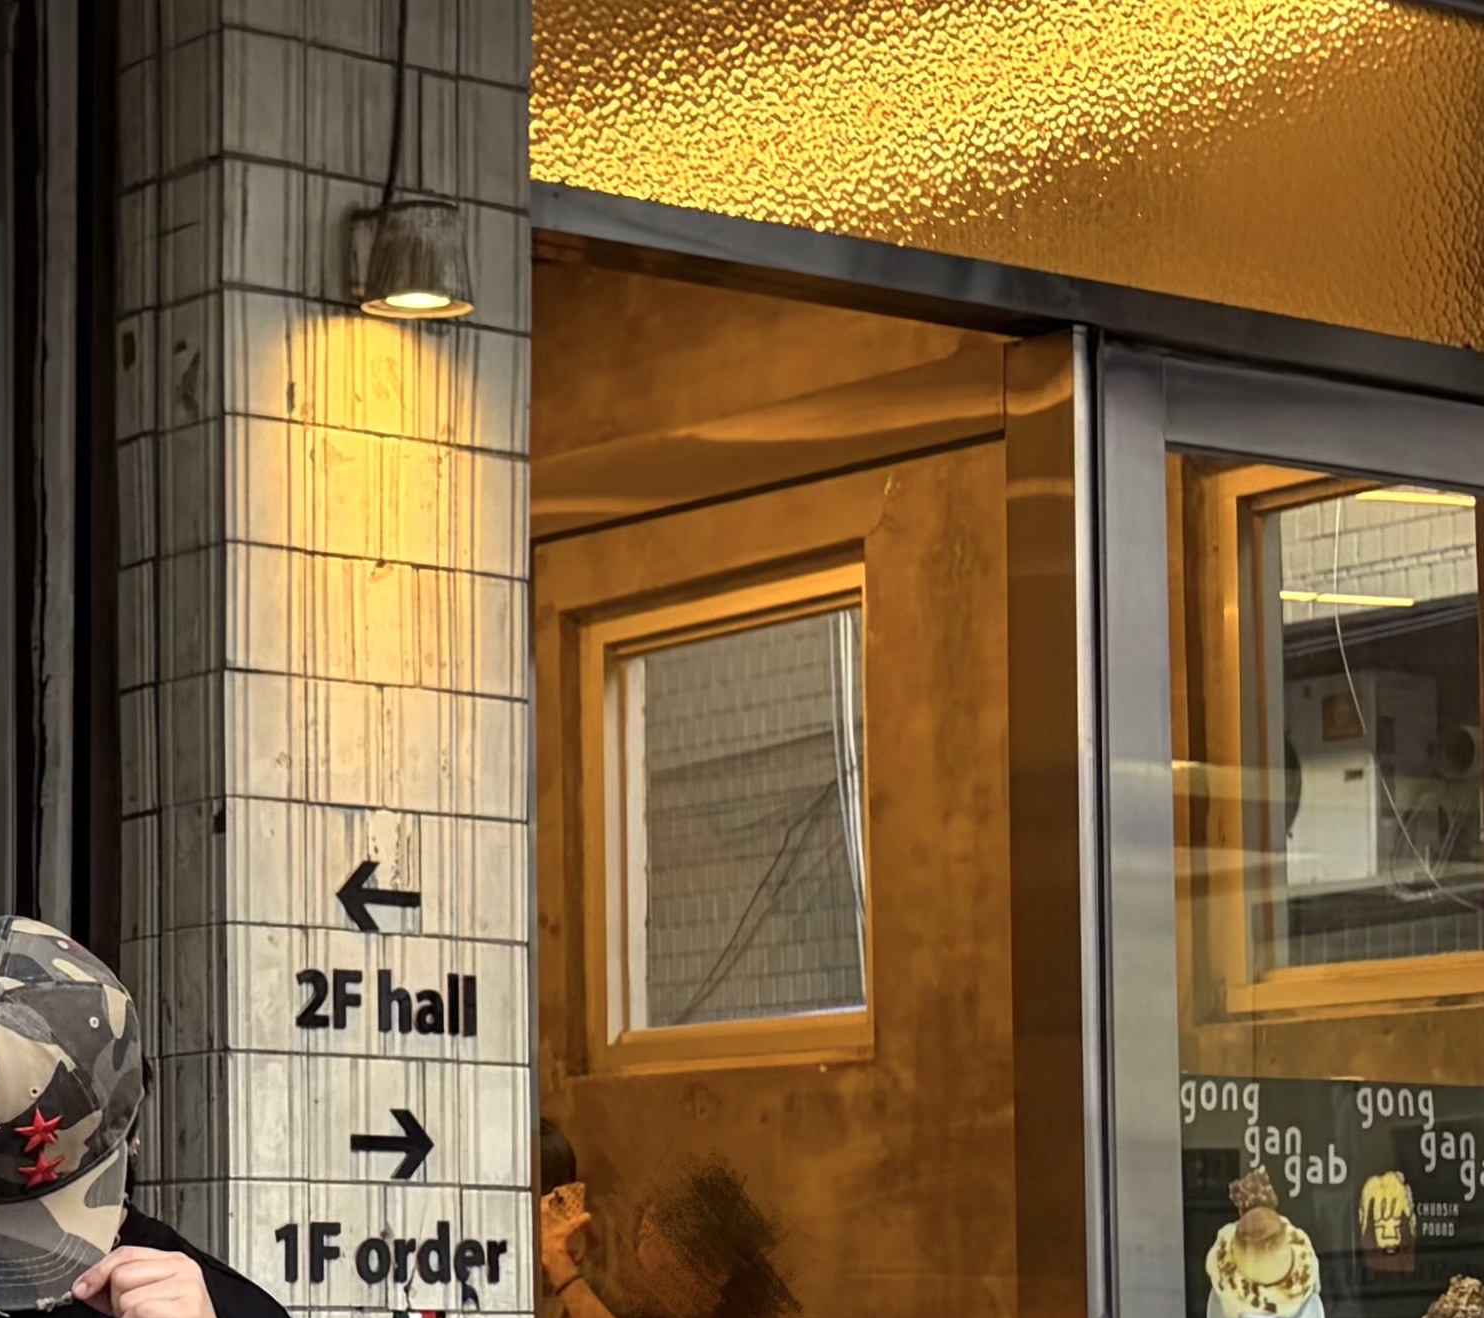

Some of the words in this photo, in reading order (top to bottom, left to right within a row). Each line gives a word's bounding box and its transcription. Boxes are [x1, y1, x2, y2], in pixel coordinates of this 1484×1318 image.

[296, 968, 362, 1030] 2F
[378, 968, 478, 1037] hall
[1181, 1080, 1260, 1125] gong
[1356, 1087, 1435, 1131] gong
[1244, 1125, 1302, 1168] gan
[1420, 1131, 1475, 1173] gan
[1284, 1143, 1347, 1198] gab
[275, 1220, 341, 1285] 1F
[355, 1220, 508, 1285] order
